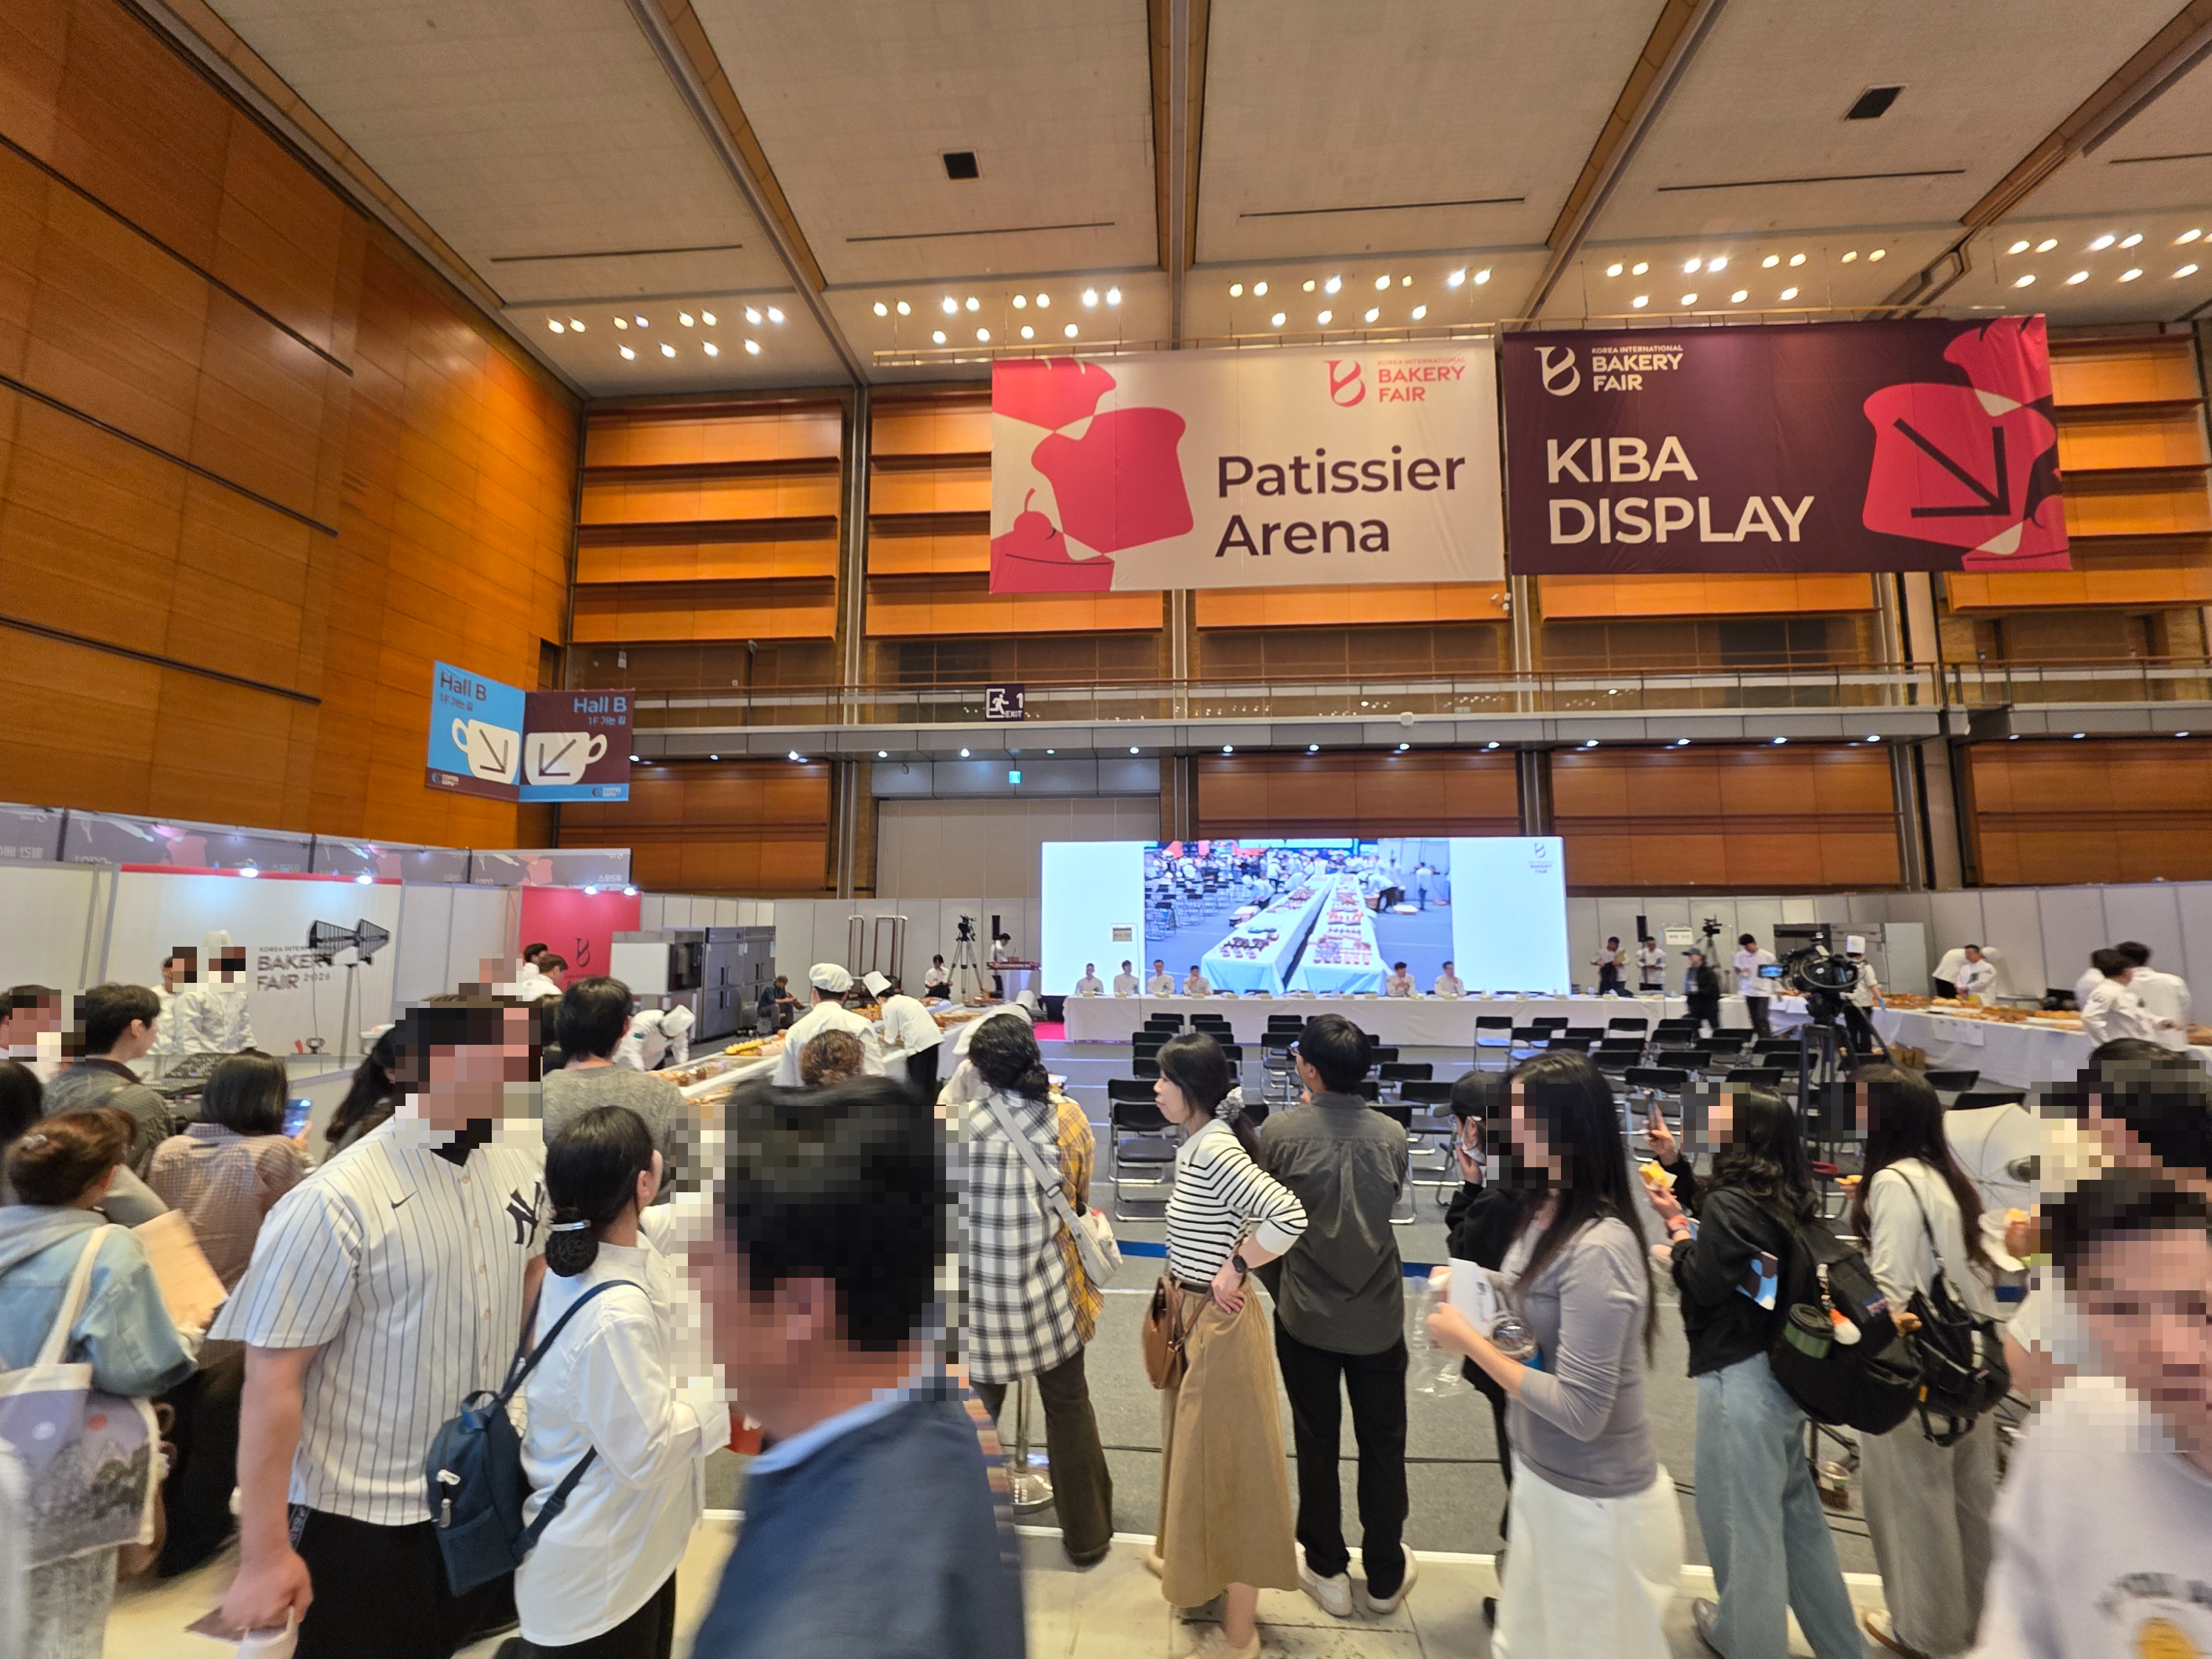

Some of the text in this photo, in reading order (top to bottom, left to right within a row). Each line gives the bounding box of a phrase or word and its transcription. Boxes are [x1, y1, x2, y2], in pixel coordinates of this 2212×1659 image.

[1620, 344, 1683, 353] INTERNATIONAL
[1405, 357, 1466, 365] INTERNATIONAL
[1592, 353, 1684, 372] BAKERY
[1378, 365, 1466, 383] BAKERY
[1593, 374, 1643, 392] FAIR
[1379, 386, 1426, 403] FAIR
[1547, 436, 1698, 484] KIBA
[1217, 445, 1466, 498] Patissier
[1549, 495, 1815, 545] DISPLAY
[1215, 515, 1391, 558] Arena
[440, 671, 487, 702] Hall B
[573, 695, 627, 714] Hall B
[1016, 692, 1023, 709] 1
[588, 716, 599, 726] 1F
[1005, 710, 1023, 718] EXIT
[257, 974, 300, 992] FAIR
[304, 973, 331, 982] 2026
